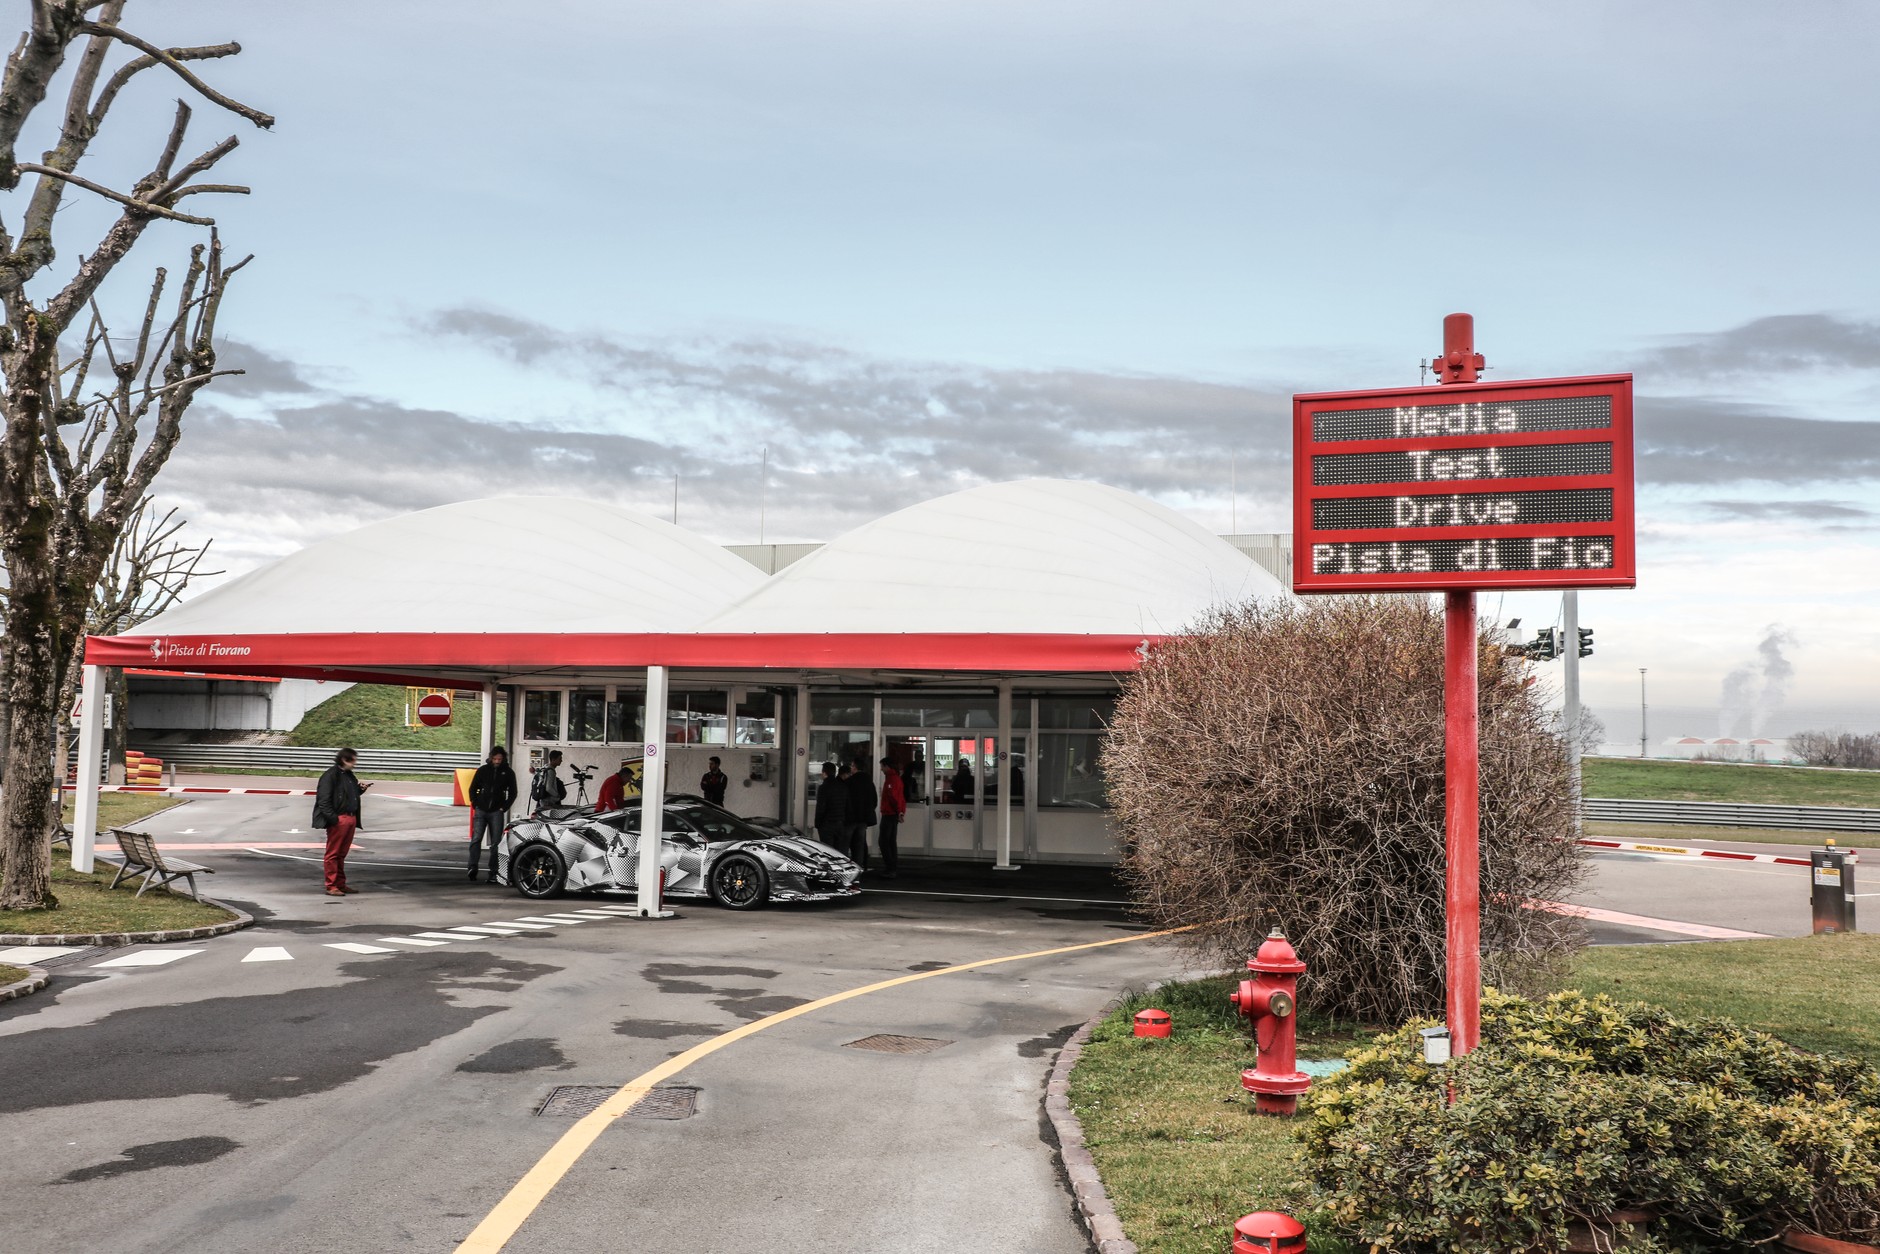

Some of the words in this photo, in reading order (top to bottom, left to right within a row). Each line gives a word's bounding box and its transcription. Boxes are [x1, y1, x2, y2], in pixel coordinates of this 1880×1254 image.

[1394, 403, 1517, 436] Media
[1408, 447, 1505, 480] Test
[1395, 494, 1517, 527] Drive
[1313, 542, 1431, 573] Pista
[1457, 539, 1501, 571] di
[1533, 537, 1610, 569] Fio
[168, 644, 194, 656] Pista
[196, 643, 206, 656] di
[209, 643, 250, 656] Fiorano
